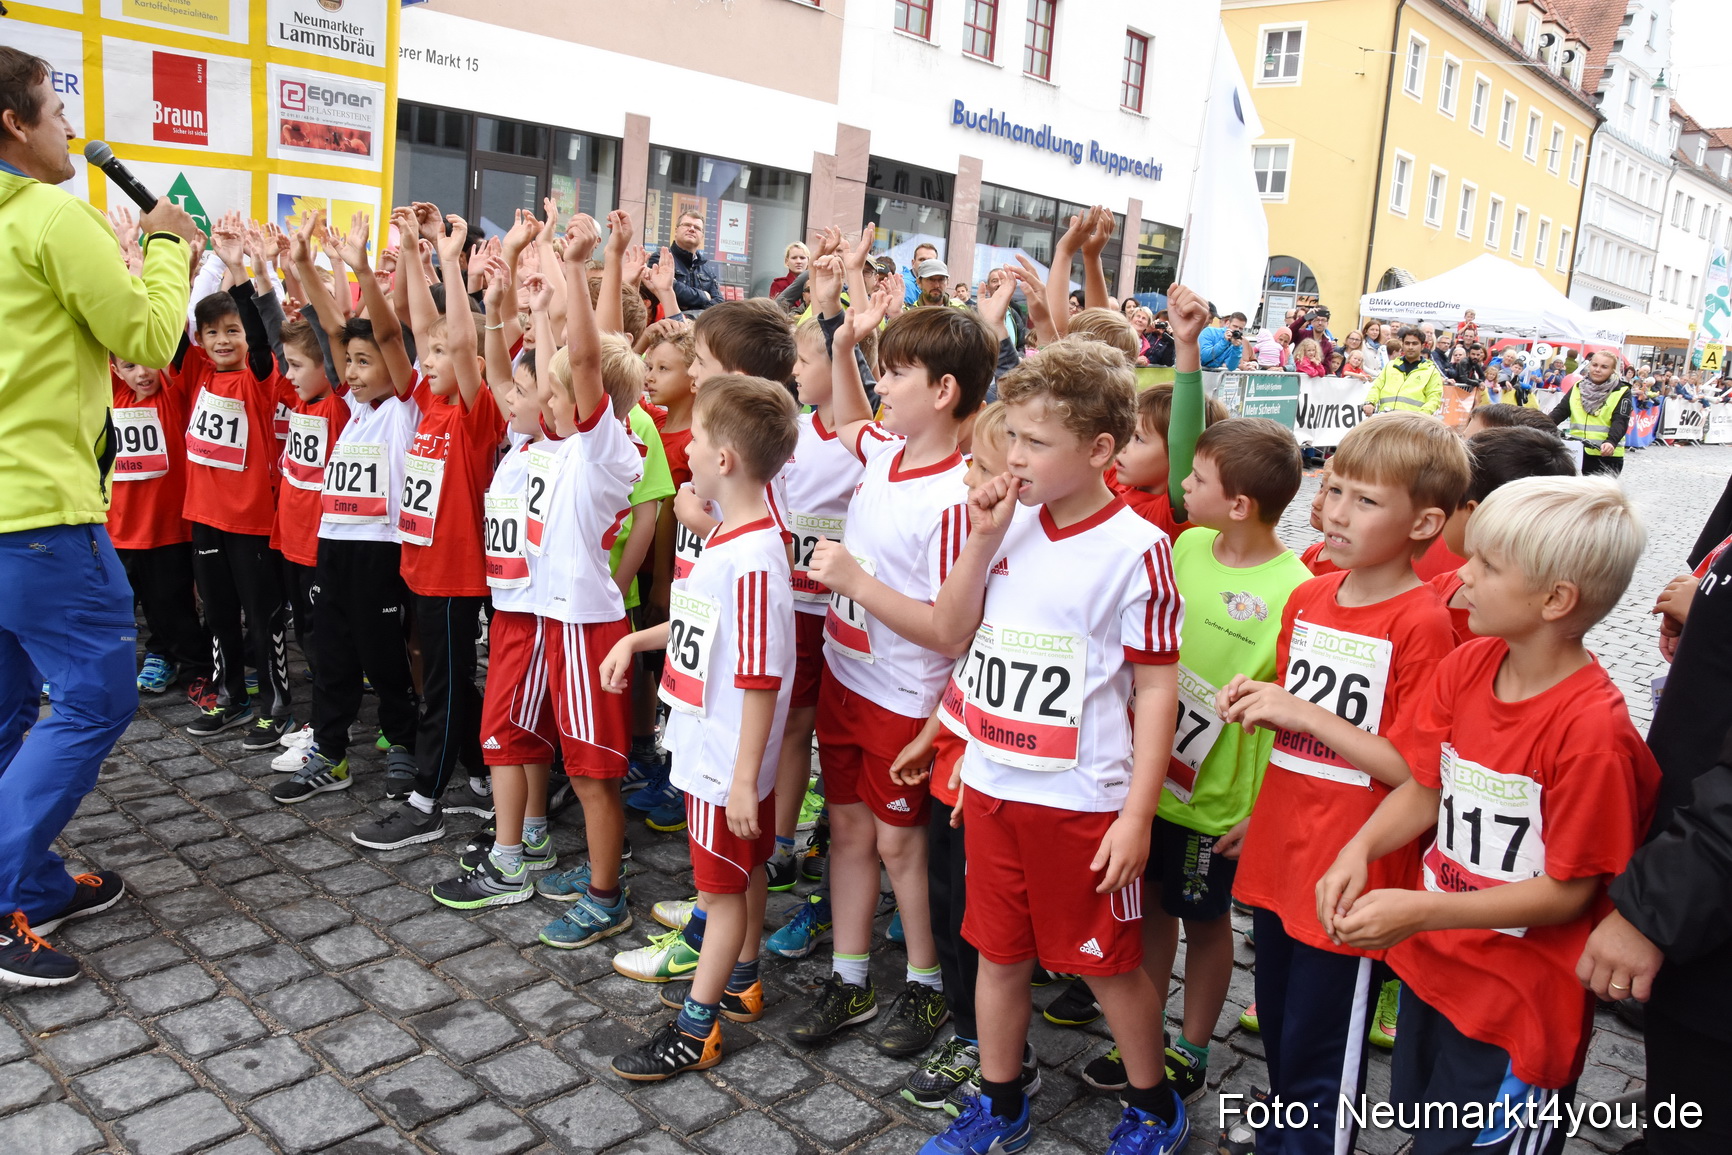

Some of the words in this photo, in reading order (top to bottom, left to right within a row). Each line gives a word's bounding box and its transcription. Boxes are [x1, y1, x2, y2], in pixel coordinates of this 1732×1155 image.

[134, 0, 218, 21] Kartoffelspezialitäten
[294, 11, 364, 36] Neumarkter
[280, 22, 374, 57] Lammsbräu
[426, 48, 461, 69] Markt
[466, 57, 479, 72] 15
[308, 86, 372, 107] Egner
[152, 101, 203, 128] Braun
[307, 105, 372, 122] PFLASTERSTEINE
[172, 127, 187, 135] Sicher
[952, 98, 1084, 165] Buchhandlung
[1088, 139, 1163, 181] Rupprecht
[1369, 298, 1391, 306] BMW
[1394, 299, 1461, 310] ConnectedDrive
[1706, 351, 1717, 364] A
[1245, 404, 1258, 416] Mehr
[1259, 403, 1280, 415] Sicherheit
[343, 444, 381, 456] BOCK
[334, 499, 358, 513] Emre
[797, 515, 844, 530] BOCK
[1002, 628, 1074, 653] BOCK
[1312, 631, 1378, 662] BOCK
[1001, 646, 1022, 655] inspired
[1048, 651, 1074, 660] concepts
[1069, 716, 1076, 725] K
[980, 717, 1038, 750] Hannes
[1190, 759, 1197, 769] K
[1454, 763, 1529, 801] BOCK
[1443, 794, 1531, 873] 117
[1079, 945, 1104, 959] adidas
